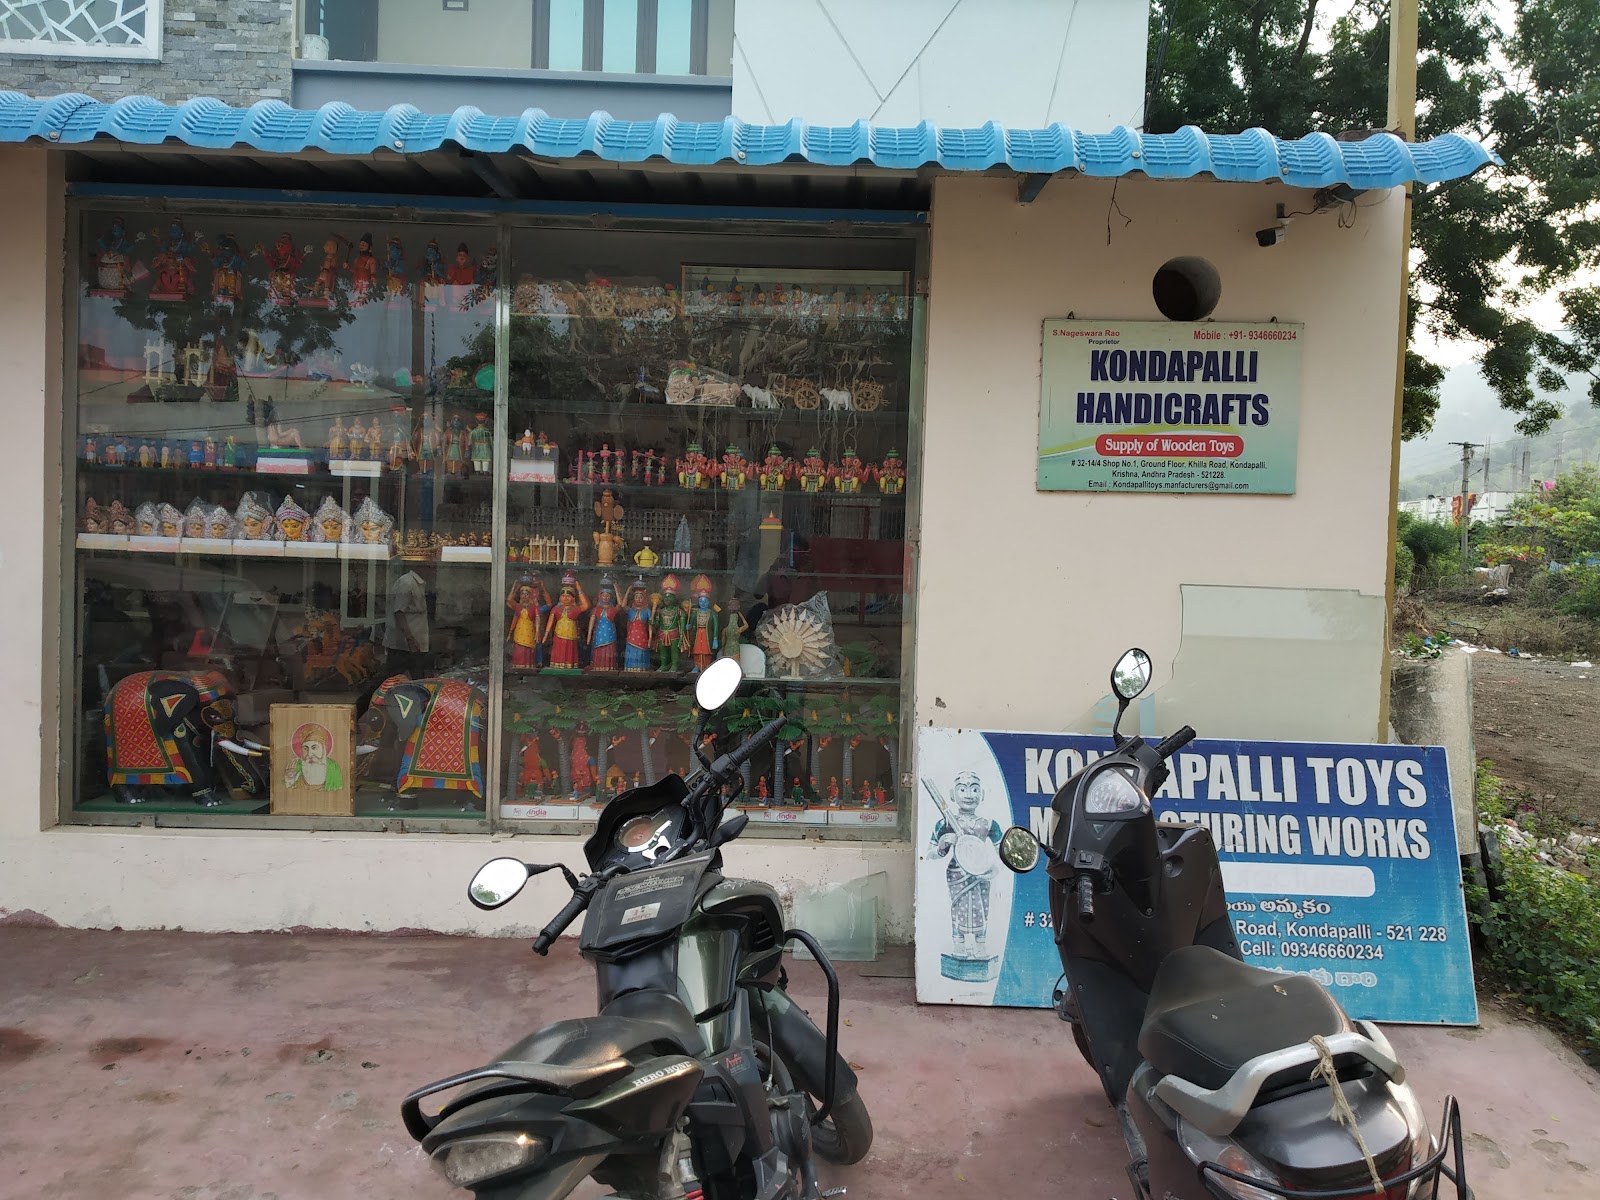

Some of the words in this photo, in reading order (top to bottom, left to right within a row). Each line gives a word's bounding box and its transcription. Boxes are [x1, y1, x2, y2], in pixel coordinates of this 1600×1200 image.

[1052, 329, 1103, 338] S.Nageswara
[1104, 329, 1120, 337] Rao
[1193, 330, 1221, 340] Mobile
[1248, 330, 1297, 341] 9346660234
[1090, 349, 1259, 383] KONDAPALLI
[1075, 392, 1270, 426] HANDICRAFTS
[1105, 438, 1144, 454] Supply
[1146, 438, 1159, 451] of
[1161, 438, 1207, 452] Wooden
[1209, 439, 1235, 455] Toys
[1077, 459, 1101, 467] 32-14/4
[1102, 459, 1120, 469] Shop
[1121, 460, 1139, 469] No.1,
[1140, 460, 1166, 468] Ground
[1167, 460, 1187, 469] Floor,
[1188, 460, 1207, 468] Khilla
[1208, 461, 1228, 470] Road,
[1229, 461, 1267, 471] Kondapalli,
[1112, 470, 1140, 479] Krishna,
[1141, 470, 1166, 478] Andhra
[1167, 471, 1195, 479] Pradesh
[1088, 480, 1107, 488] Email
[1112, 480, 1250, 491] Kondapallitoys.manfacturers@gmail.com
[1024, 747, 1298, 803] KOAPALLI
[1306, 757, 1428, 808] TOYS
[1306, 815, 1431, 861] WORKS
[1259, 898, 1331, 919] అమ్మకం
[1023, 911, 1035, 928] #
[1235, 920, 1283, 939] Road,
[1286, 921, 1372, 942] Kondapalli
[1386, 924, 1413, 941] 521
[1418, 926, 1448, 942] 228
[1240, 940, 1277, 956] Cell:
[1281, 941, 1384, 960] 09346660234
[631, 1069, 665, 1088] HERO
